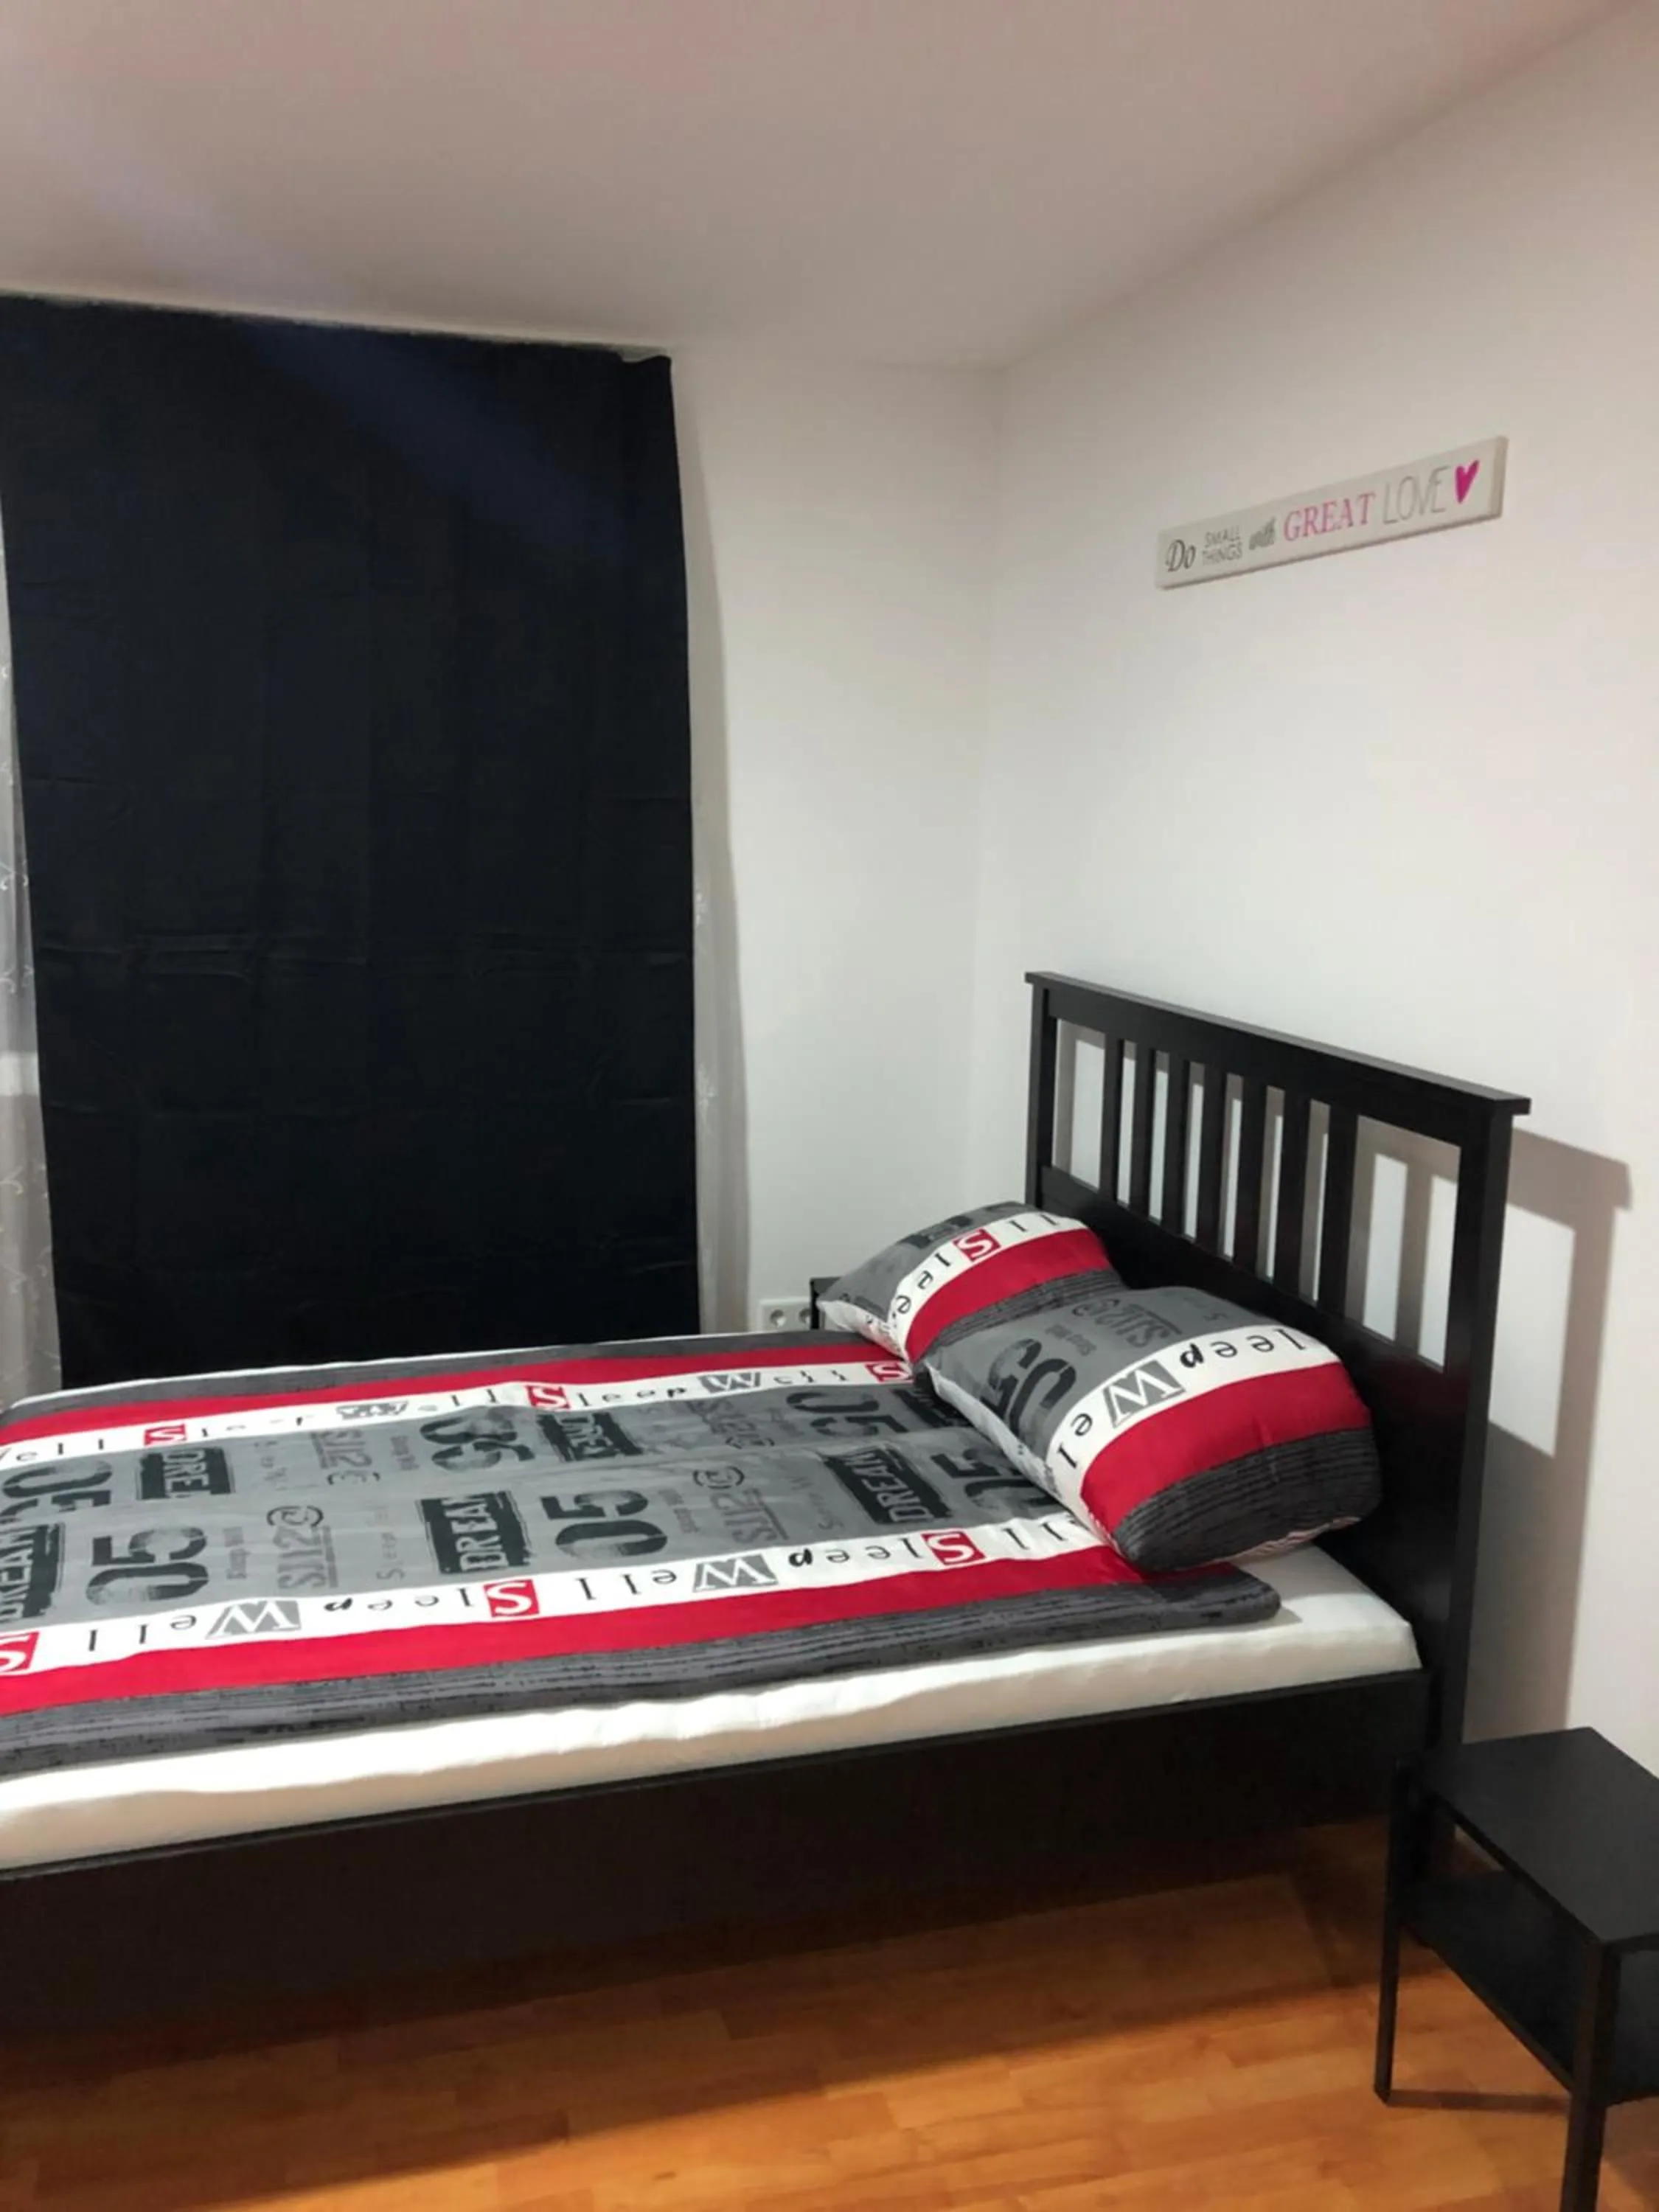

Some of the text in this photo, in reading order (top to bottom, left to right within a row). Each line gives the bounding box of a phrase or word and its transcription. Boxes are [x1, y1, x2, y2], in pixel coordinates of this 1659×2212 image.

[1166, 466, 1452, 572] Do SMALL with GREAT LOVE
[1202, 541, 1243, 566] THINGS
[890, 1227, 1001, 1321] Slee
[1180, 1328, 1306, 1368] leep
[1055, 1360, 1186, 1470] Wel
[540, 1489, 668, 1558] 05
[86, 1526, 209, 1605] 05
